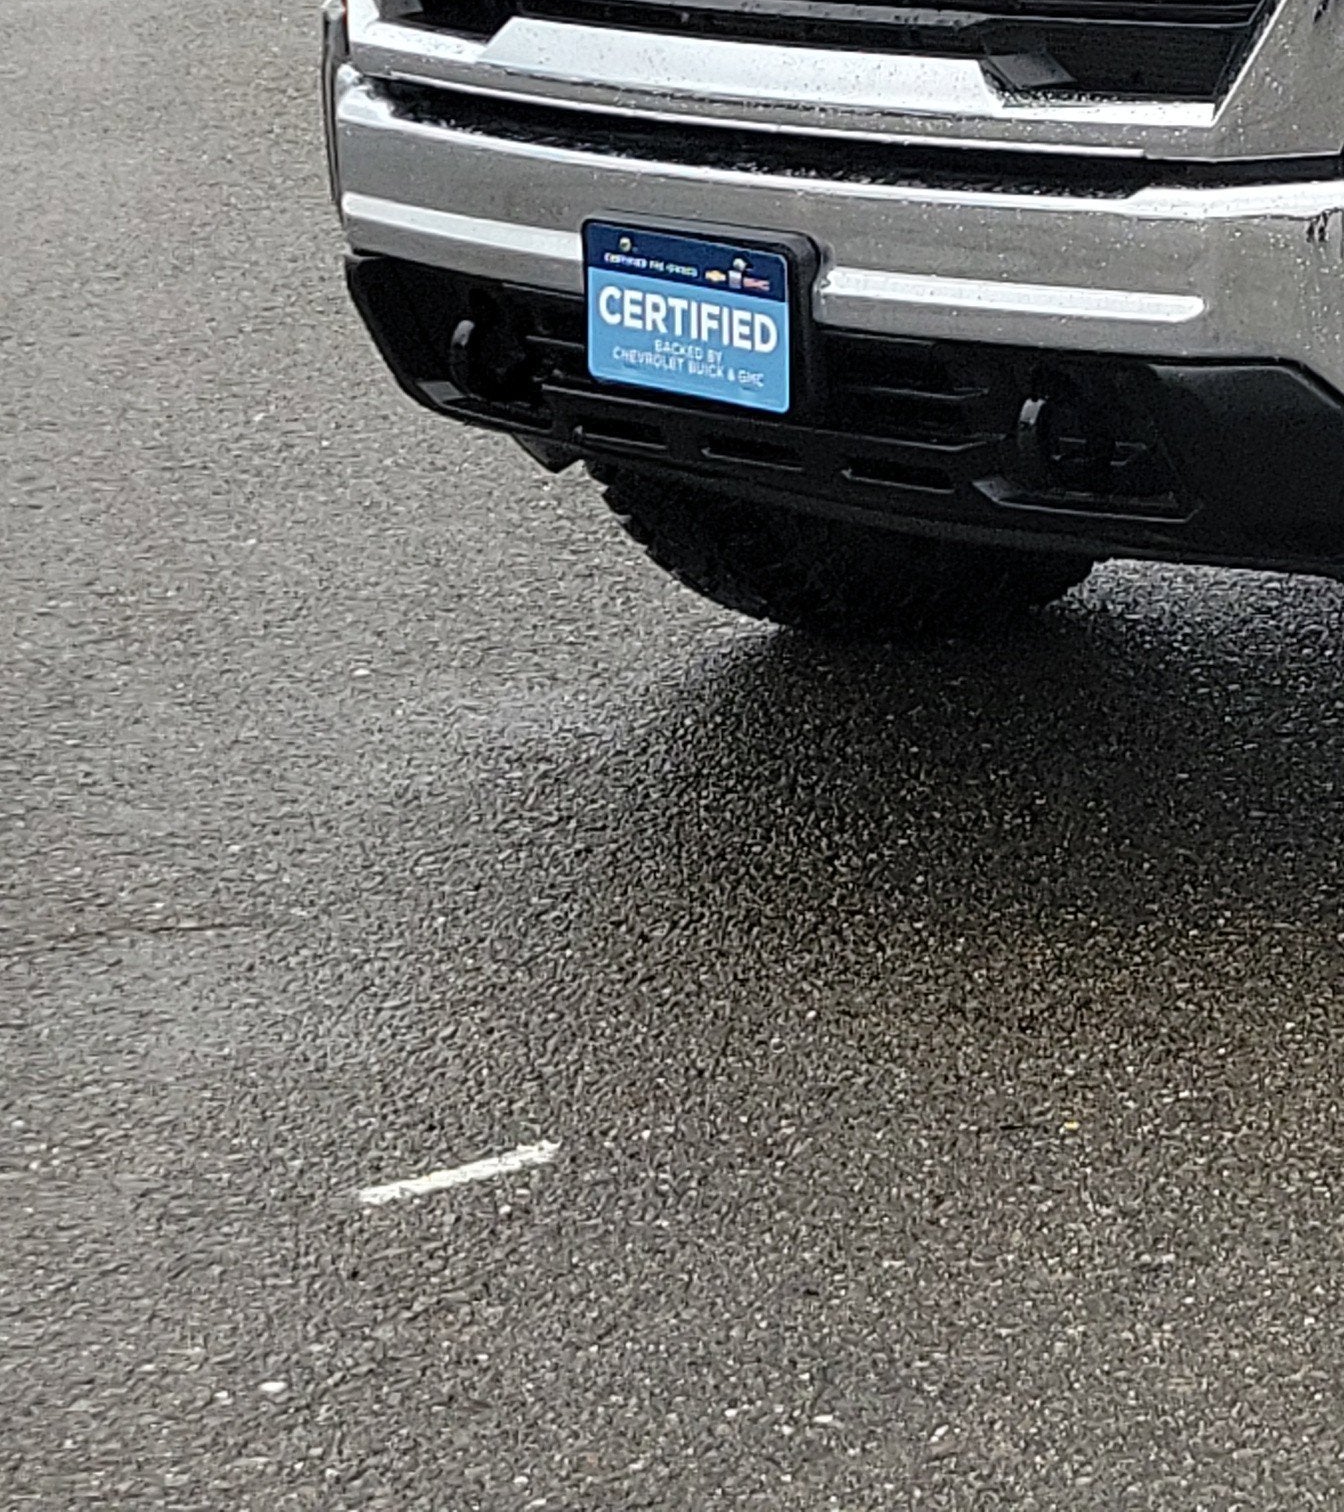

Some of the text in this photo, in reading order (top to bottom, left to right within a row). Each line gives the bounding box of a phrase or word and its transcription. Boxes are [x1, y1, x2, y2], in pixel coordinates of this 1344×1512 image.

[599, 285, 778, 354] CERTIFIED
[612, 345, 685, 370] CHEVROLET
[688, 359, 724, 380] BUICK
[654, 339, 723, 364] BACKED BY
